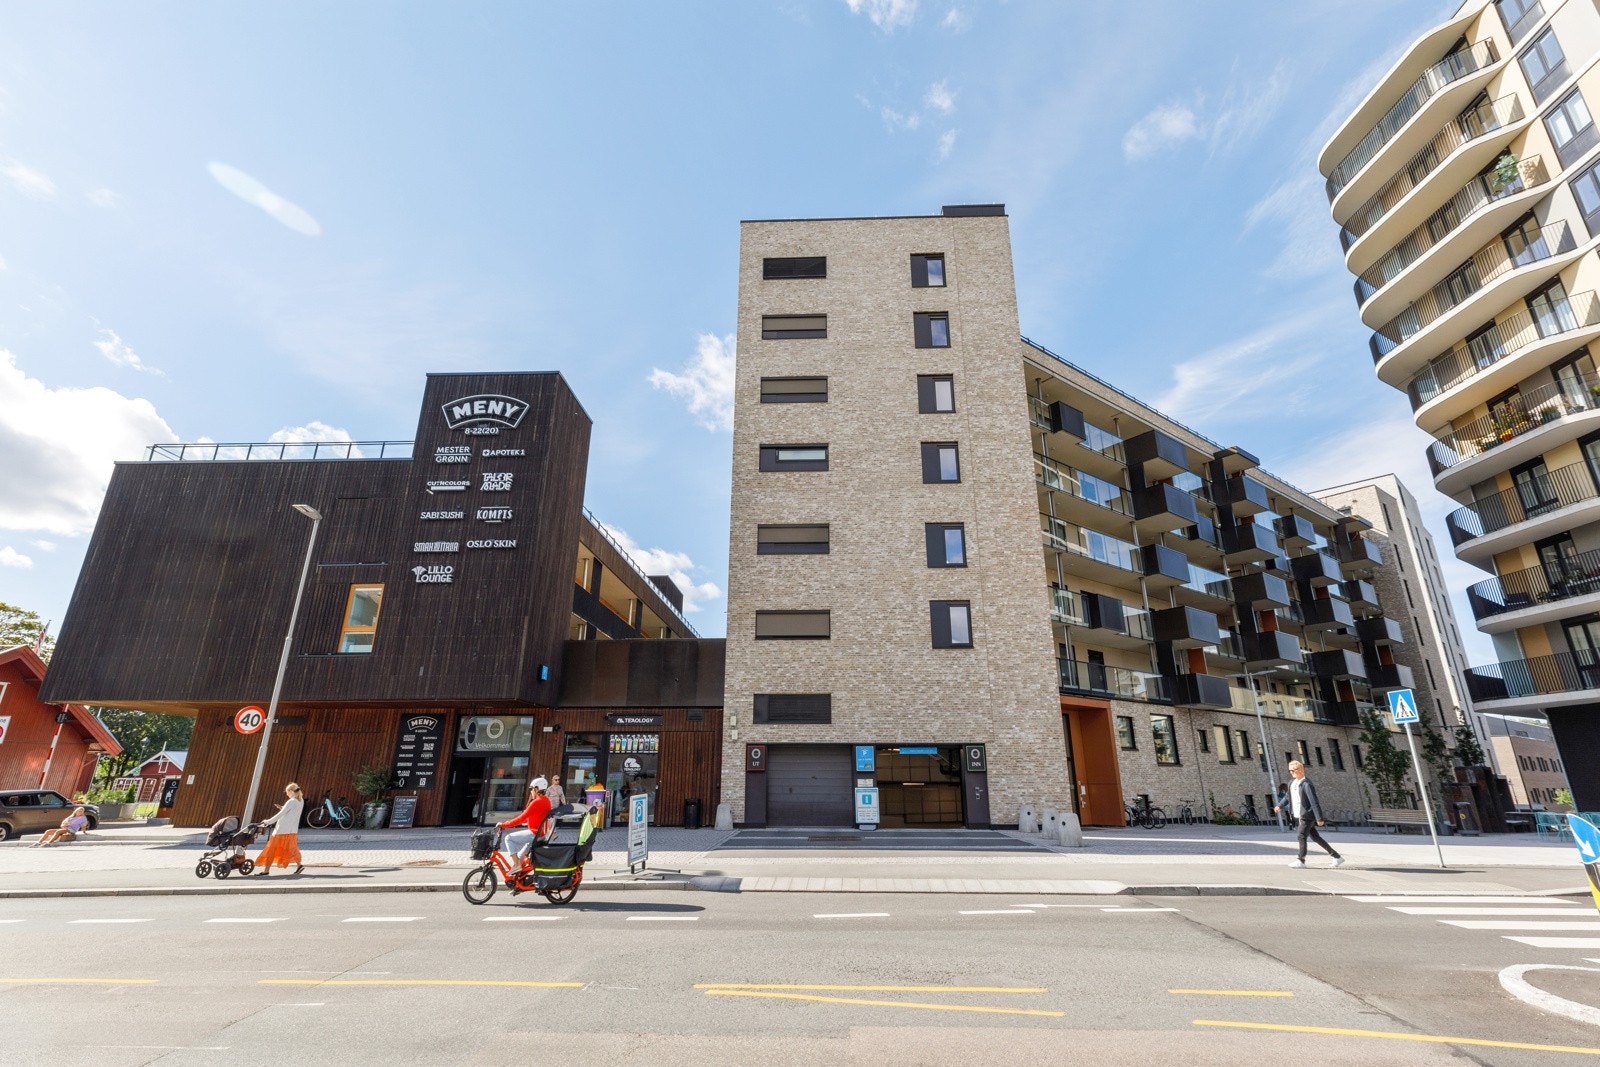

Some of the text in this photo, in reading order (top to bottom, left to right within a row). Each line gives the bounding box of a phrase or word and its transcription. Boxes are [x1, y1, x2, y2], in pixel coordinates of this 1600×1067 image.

[452, 400, 520, 420] MENY
[435, 455, 468, 463] GRØNN
[420, 511, 464, 519] SABI SUSHI
[476, 509, 513, 519] KOMPIS
[466, 539, 517, 548] OSLO SKIN
[428, 565, 454, 574] LILLO
[415, 574, 453, 583] LOUNGE
[240, 713, 261, 727] 40
[411, 718, 435, 727] MENY
